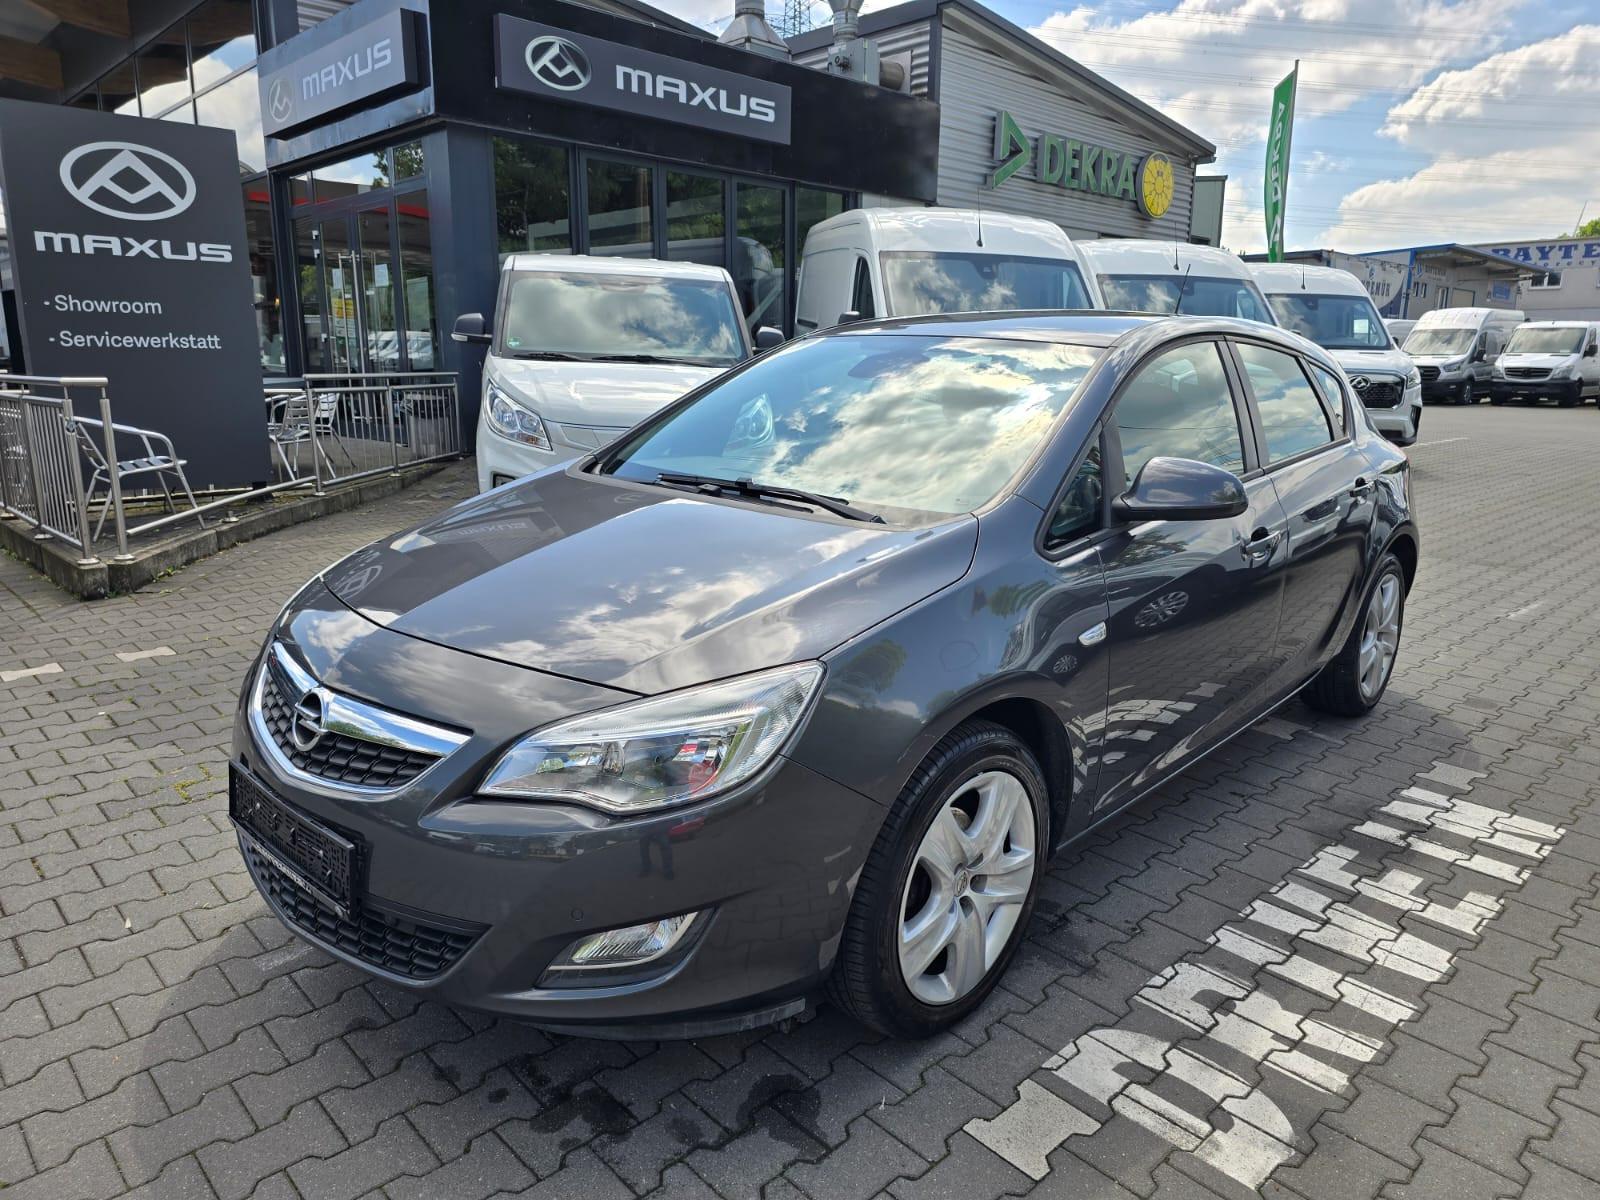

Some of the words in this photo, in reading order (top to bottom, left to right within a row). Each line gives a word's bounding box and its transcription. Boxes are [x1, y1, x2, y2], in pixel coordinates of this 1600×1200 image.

[303, 38, 392, 101] MAXUS
[616, 65, 776, 123] MAXUS
[1038, 131, 1137, 200] DEKRA
[1270, 101, 1287, 203] DEKRA
[34, 230, 233, 264] MAXUS
